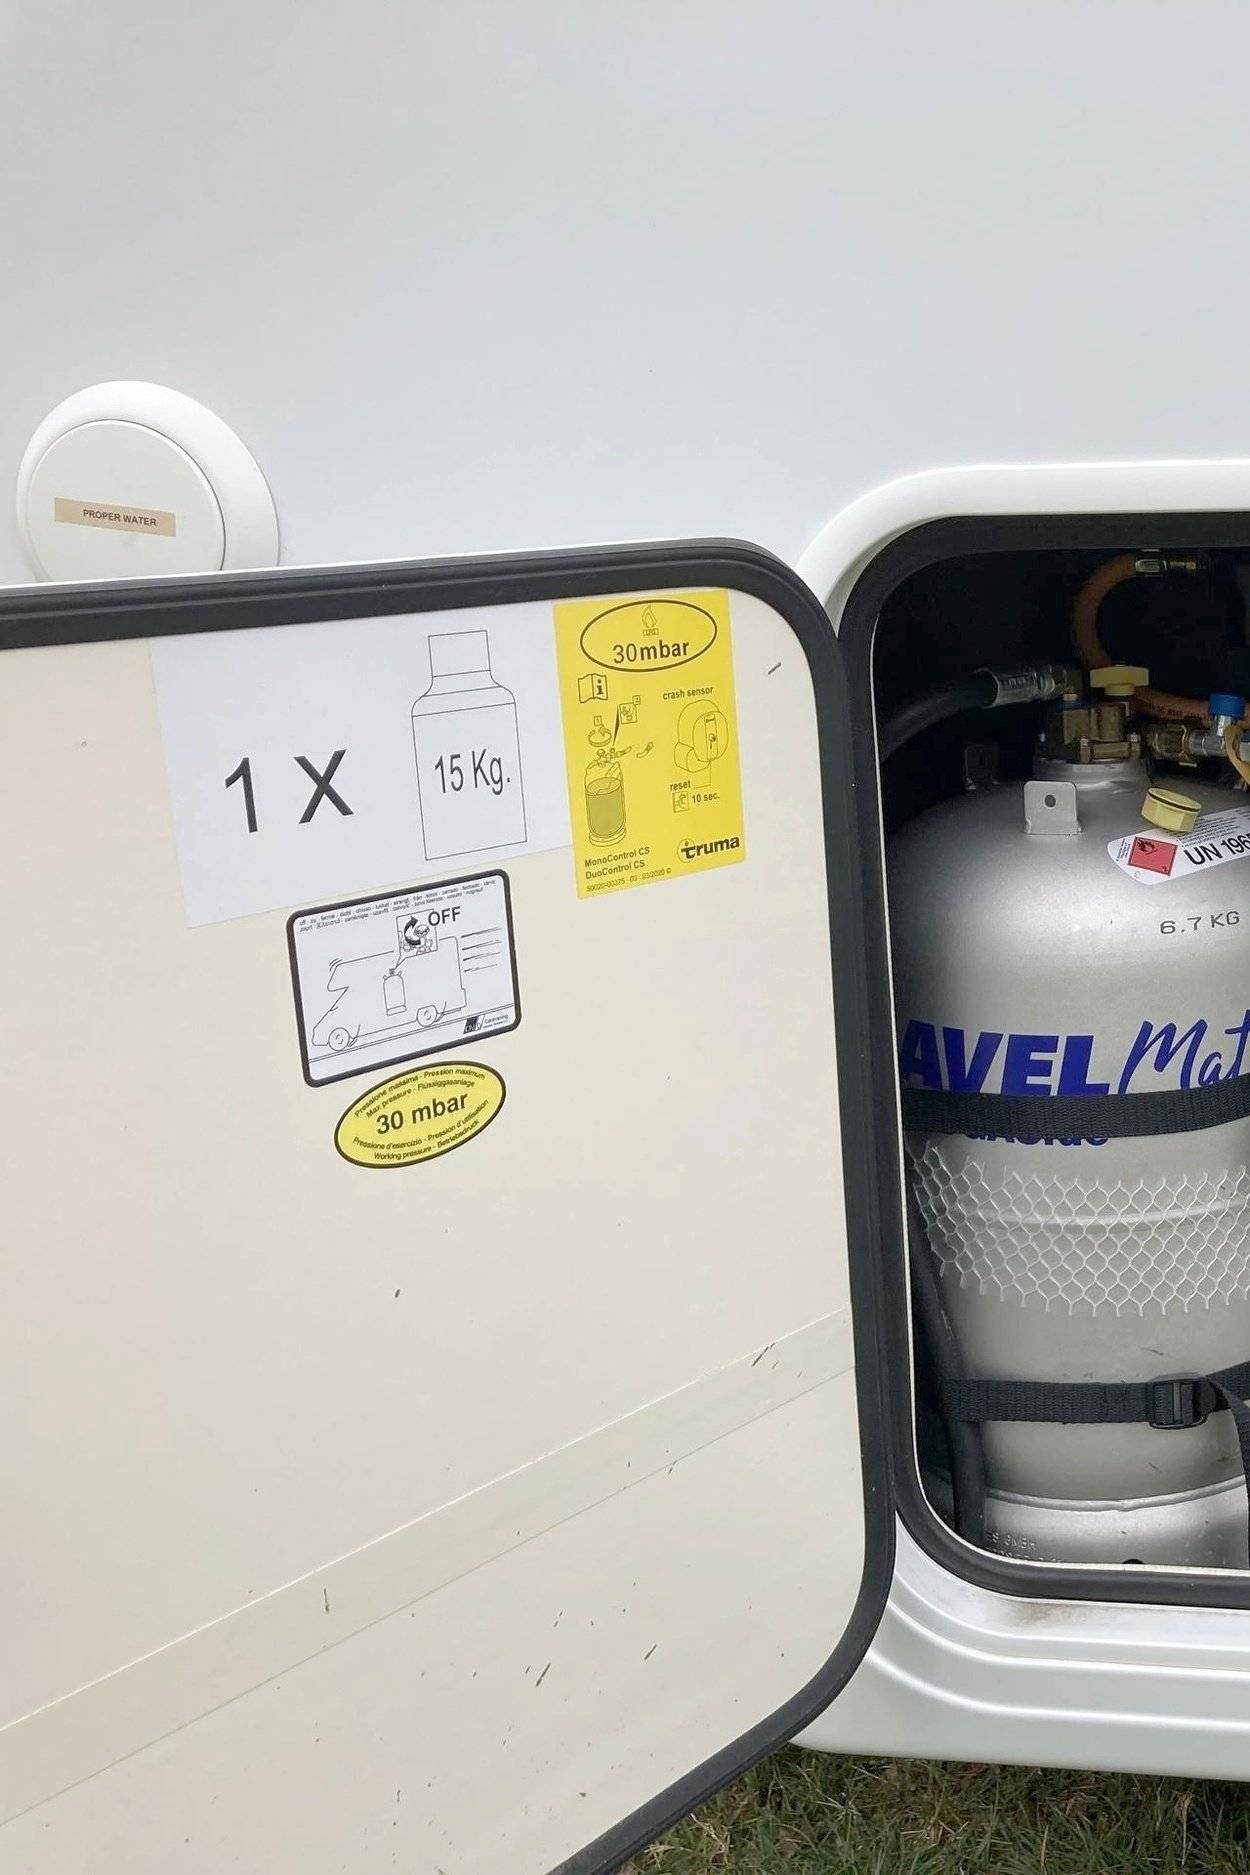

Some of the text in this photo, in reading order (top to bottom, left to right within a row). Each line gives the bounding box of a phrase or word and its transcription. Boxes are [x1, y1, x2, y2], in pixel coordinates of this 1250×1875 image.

[83, 509, 157, 526] PROPER WATER
[663, 687, 713, 700] crash sensor
[434, 748, 512, 796] 15 Kg.
[224, 756, 258, 833] 1
[670, 780, 691, 791] reset
[691, 793, 720, 805] 10 sec.
[585, 846, 650, 867] MonoControl CS
[681, 836, 740, 859] truma
[1184, 842, 1223, 865] UN
[585, 859, 645, 879] DuoControl CS
[428, 906, 460, 926] OFF
[1160, 911, 1240, 934] 6.7 KG
[354, 1068, 486, 1117] Pressione massima Pression maximum
[366, 1105, 381, 1118] Max
[382, 1088, 412, 1108] pressure
[376, 1093, 468, 1135] 30 mbar
[352, 1136, 385, 1150] Pressione
[428, 1125, 456, 1141] Pression
[373, 1119, 480, 1161] Working pressure Betriebsdruck
